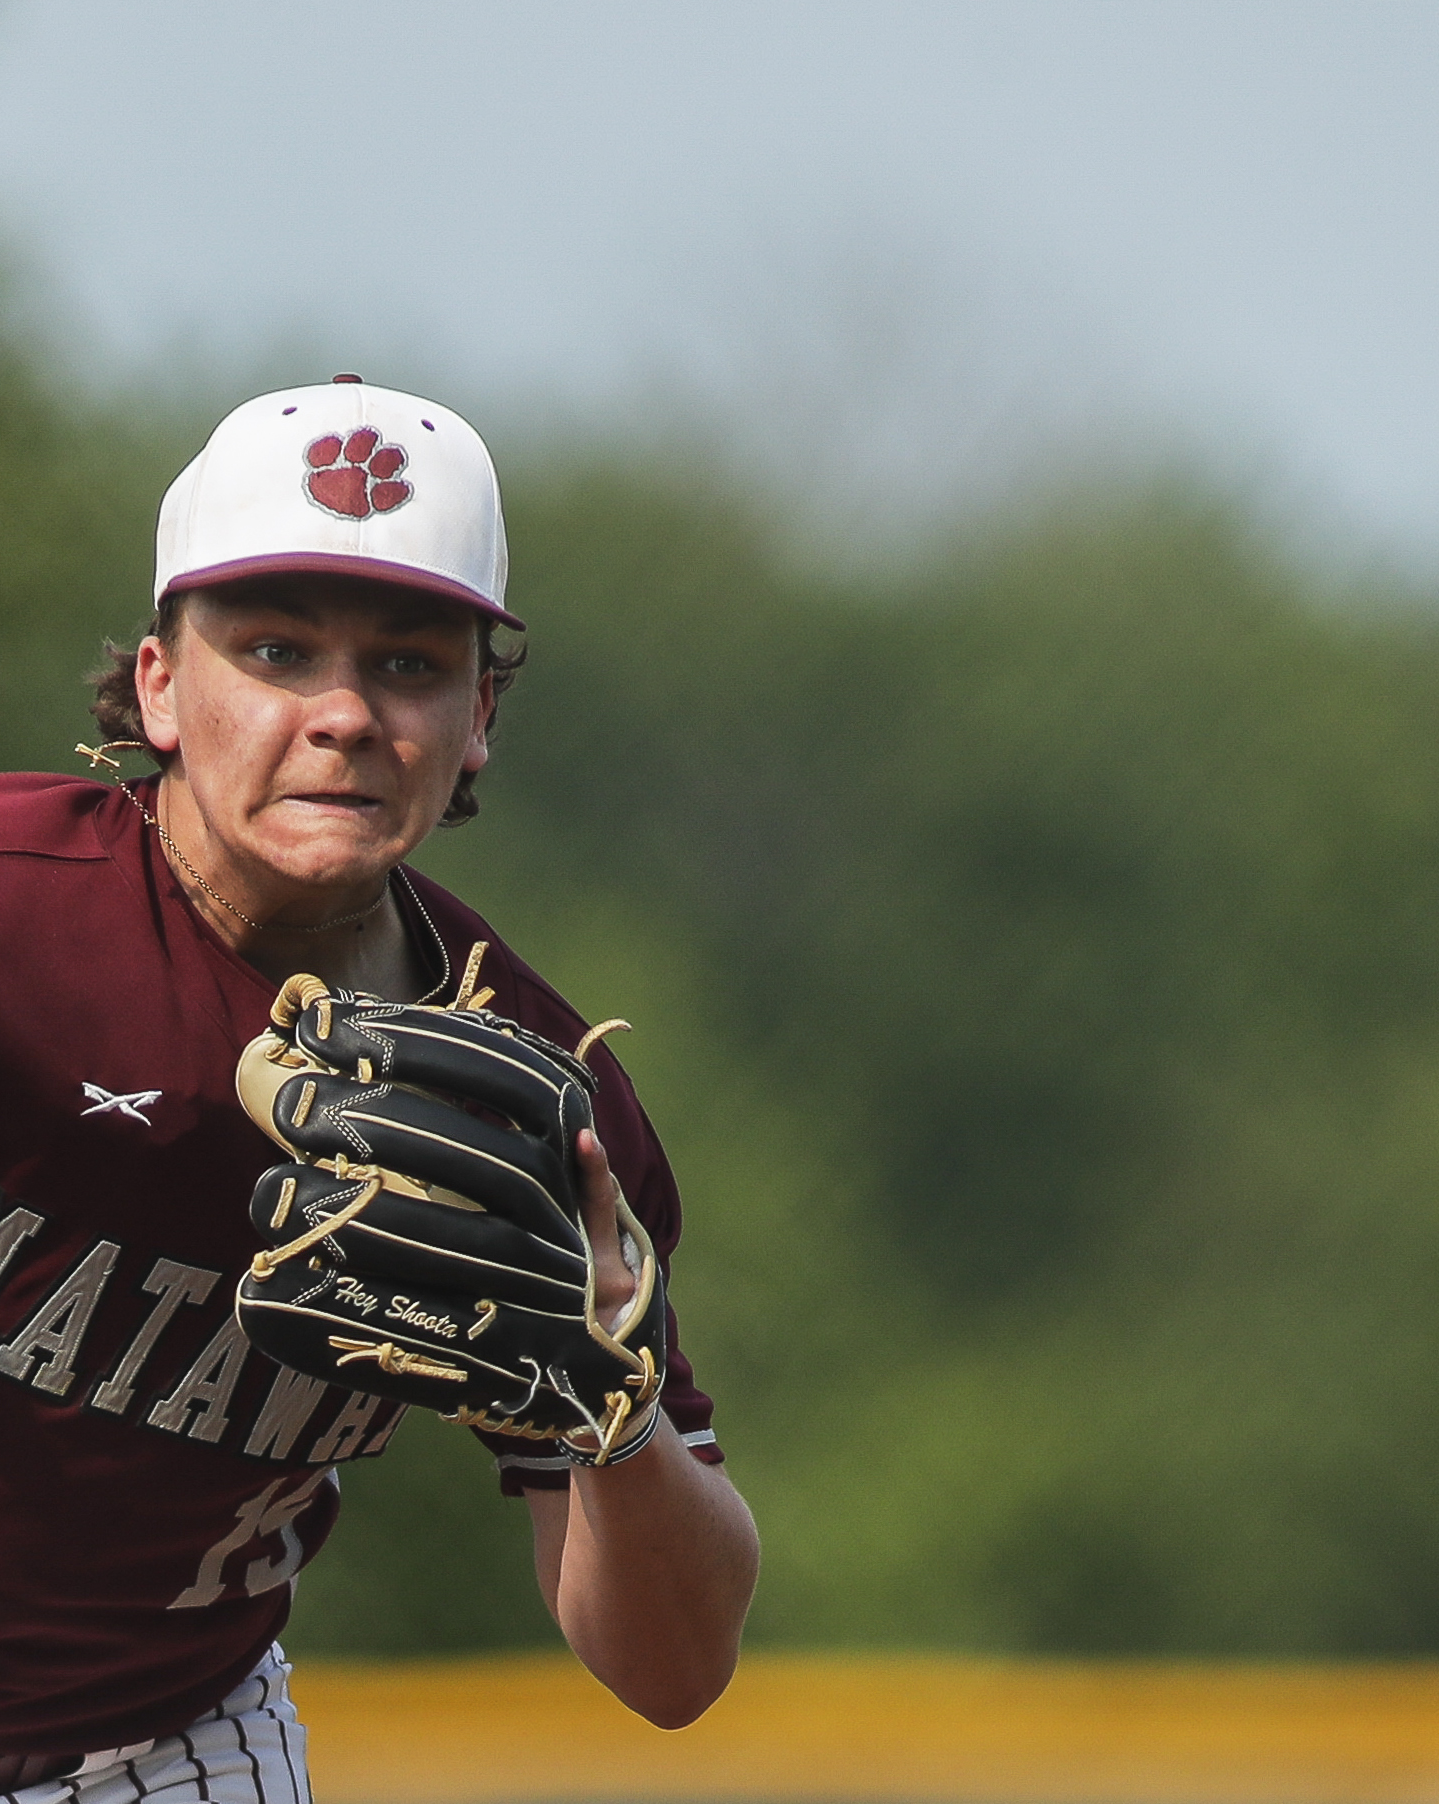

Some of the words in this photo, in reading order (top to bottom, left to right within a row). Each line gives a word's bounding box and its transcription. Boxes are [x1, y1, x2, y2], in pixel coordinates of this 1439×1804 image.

[334, 1276, 379, 1317] Hey
[384, 1295, 459, 1339] Shoota
[165, 1465, 336, 1610] 15
